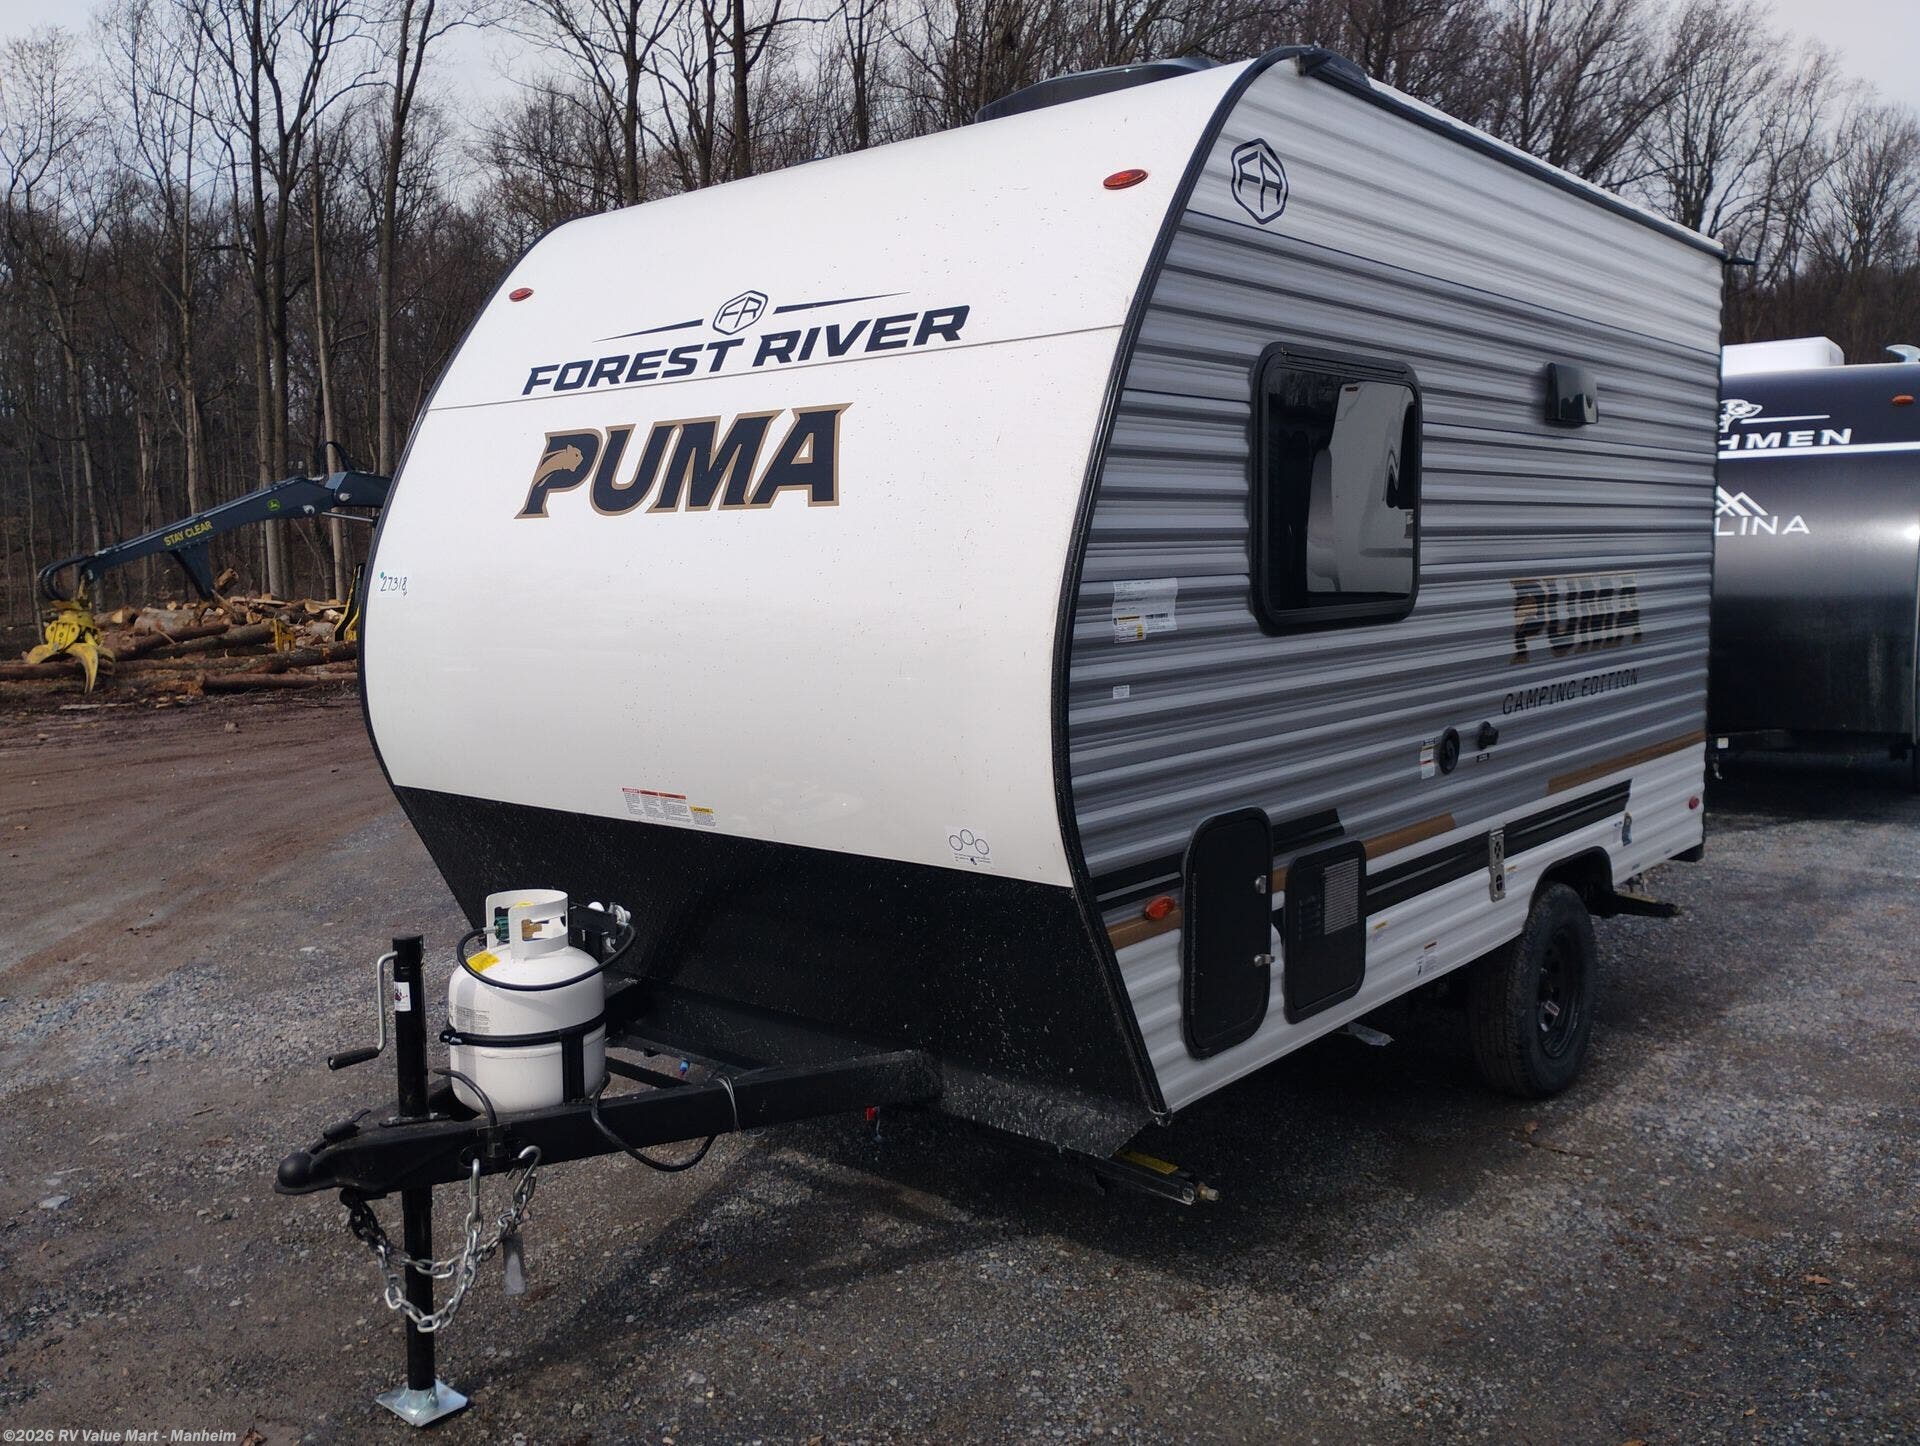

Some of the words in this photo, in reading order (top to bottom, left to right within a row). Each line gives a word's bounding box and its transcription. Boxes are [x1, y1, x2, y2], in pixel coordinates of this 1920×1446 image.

[522, 338, 744, 396] FOREST
[752, 304, 970, 367] RIVER
[514, 402, 853, 519] PUMA
[163, 531, 184, 546] STAY
[184, 520, 213, 538] CLEAR
[1510, 570, 1643, 664] PUMA
[1502, 680, 1577, 715] CAMPING
[1581, 667, 1641, 697] EDITION
